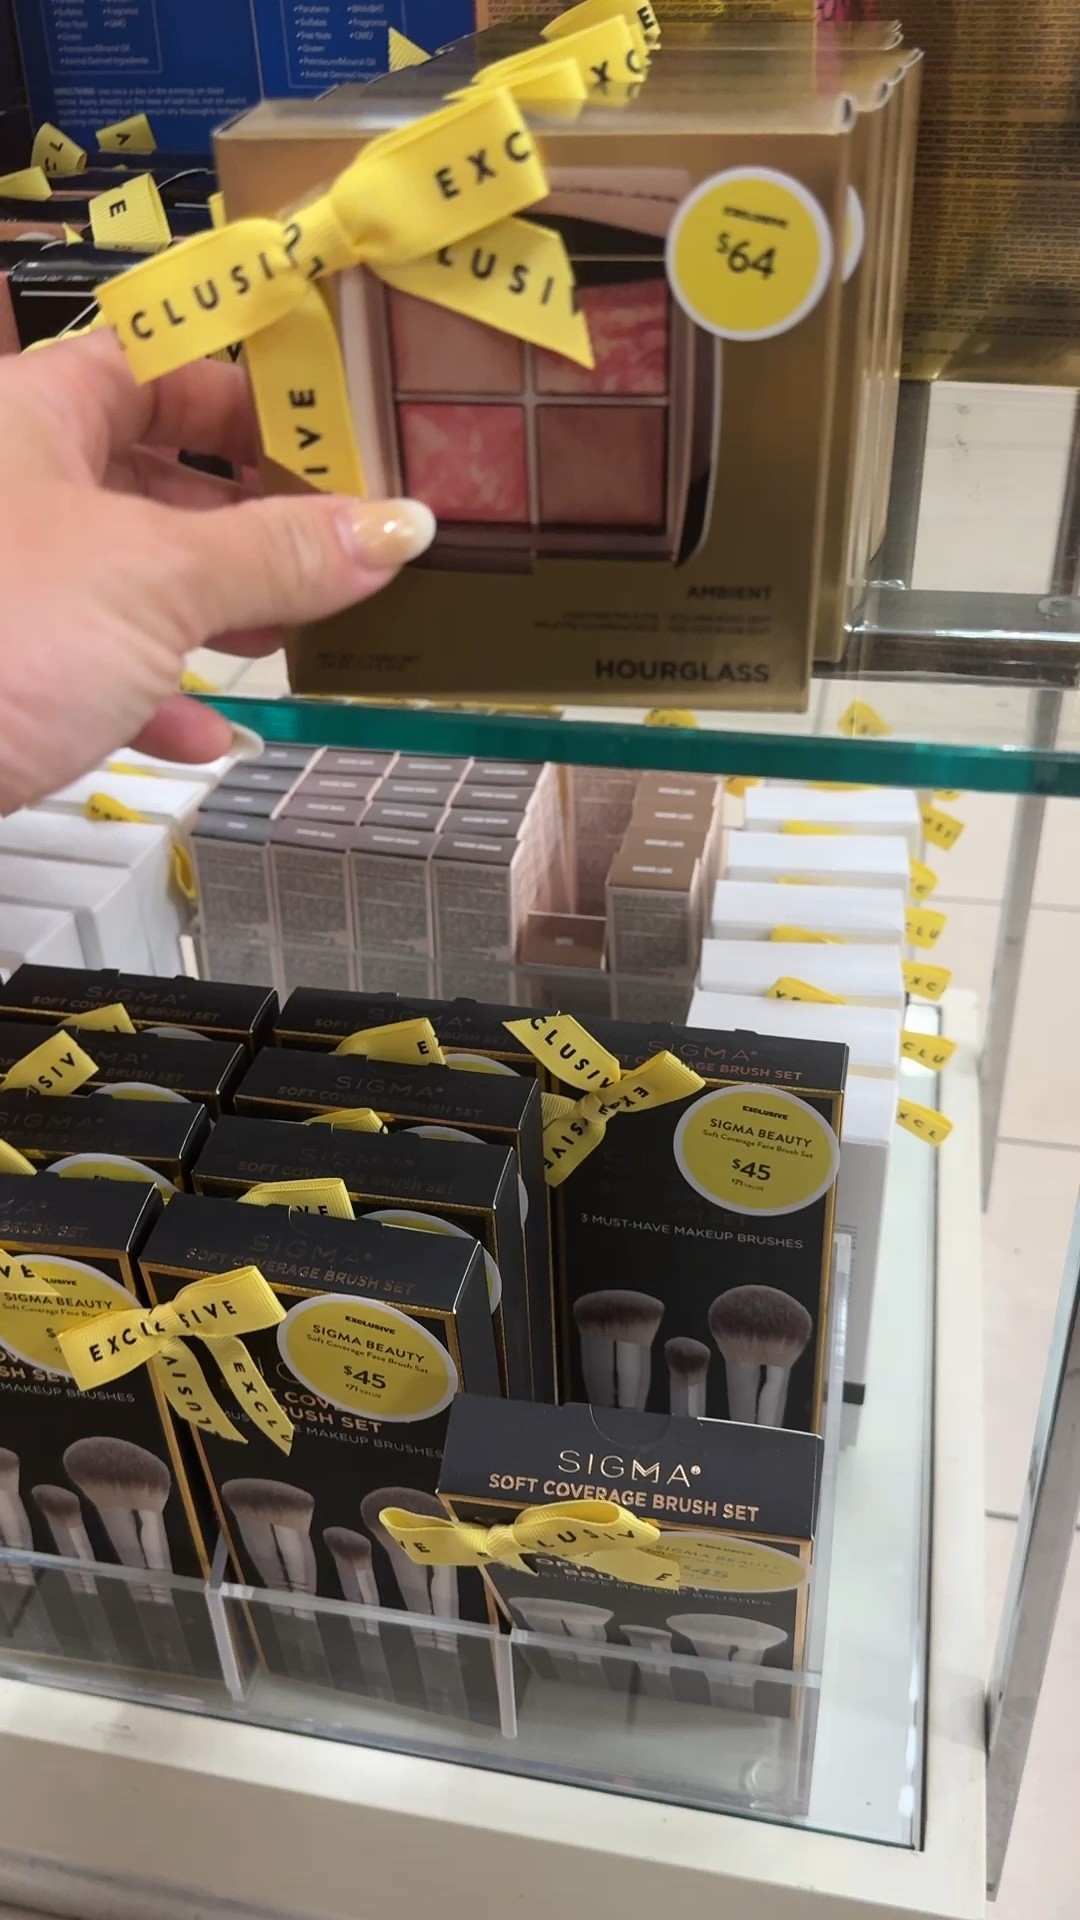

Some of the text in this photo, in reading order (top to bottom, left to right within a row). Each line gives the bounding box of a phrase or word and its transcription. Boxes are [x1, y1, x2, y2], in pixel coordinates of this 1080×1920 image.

[716, 231, 777, 281] $64
[687, 584, 772, 601] AMBIENT
[594, 657, 771, 684] HOURGLASS
[719, 1063, 771, 1078] BRUSH
[774, 1069, 804, 1082] SET
[742, 1105, 788, 1121] EXCLUSIVE
[702, 1129, 814, 1159] Soft Coverage Face Brush Set
[709, 1118, 813, 1148] SIGMA BEAUTY
[731, 1158, 772, 1181] $45
[579, 1212, 805, 1250] 3 MUST-HAVE MAKEUP BRUSHES
[323, 1269, 380, 1290] BRUSH
[382, 1279, 417, 1296] SET
[4, 1291, 113, 1310] SIGMA BEAUTY
[344, 1314, 396, 1335] EXCLUSIVE
[306, 1333, 325, 1345] Soft
[325, 1339, 365, 1358] Coverage
[367, 1351, 387, 1362] Face
[387, 1357, 414, 1371] Brush
[311, 1323, 425, 1364] SIGMA BEAUTY
[343, 1365, 387, 1390] $45
[1, 1381, 136, 1404] MAKEUP BRUSHES
[340, 1415, 383, 1435] SET
[305, 1426, 444, 1459] MAKEUP BRUSHES
[488, 1472, 760, 1523] SOFT COVERAGE BRUSH SET
